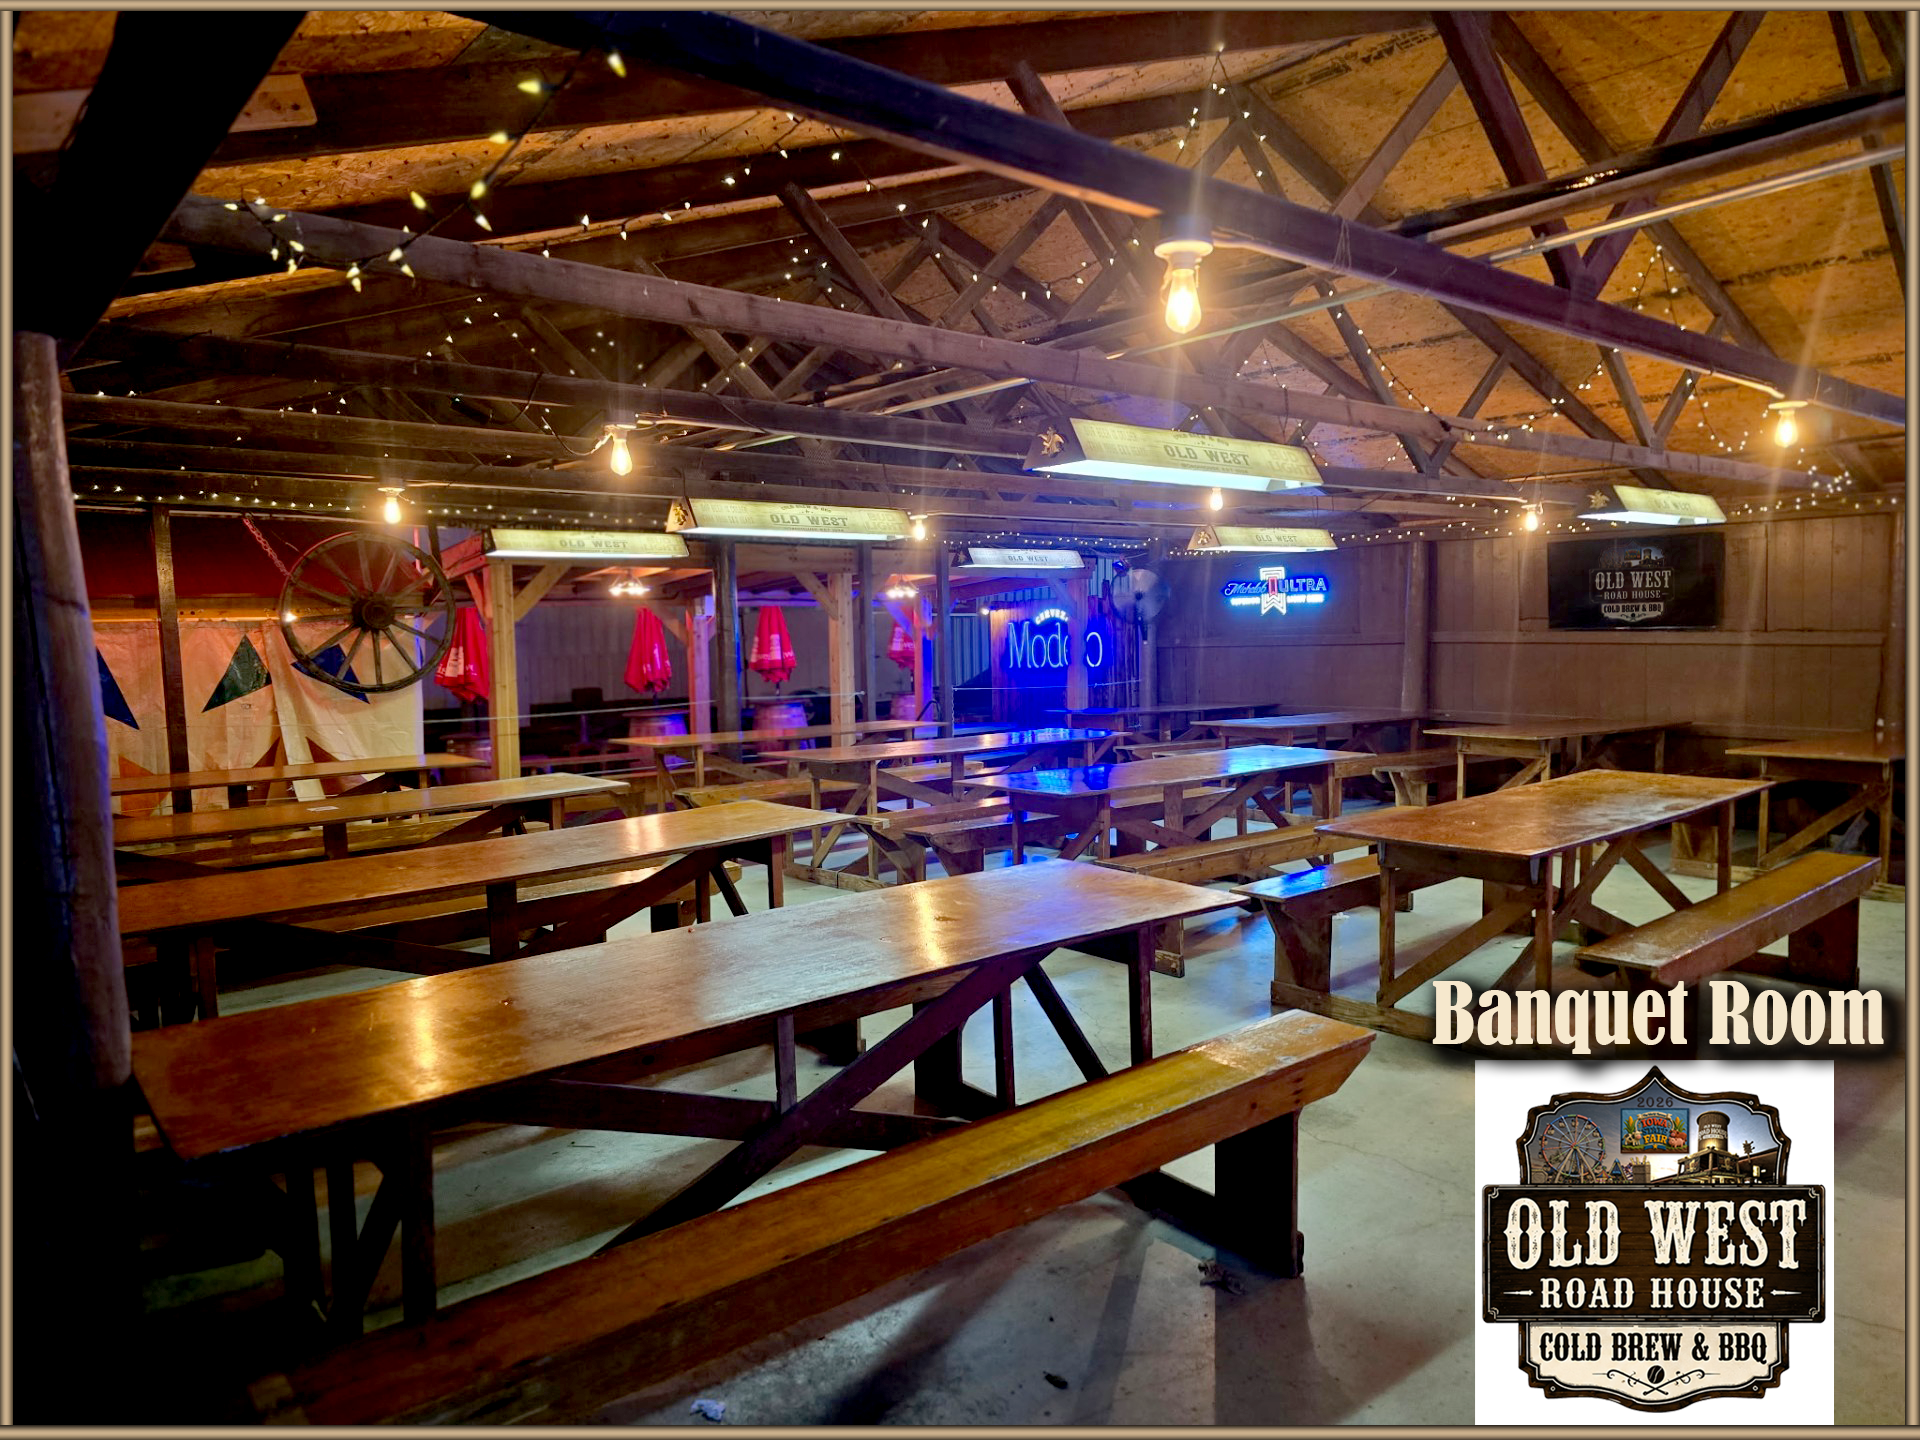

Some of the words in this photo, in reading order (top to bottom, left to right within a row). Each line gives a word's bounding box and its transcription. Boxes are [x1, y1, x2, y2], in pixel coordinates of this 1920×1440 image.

[1163, 444, 1199, 460] OLD
[1204, 449, 1249, 466] WEST
[1267, 448, 1298, 463] BUD
[769, 513, 800, 525] OLD
[807, 515, 848, 527] WEST
[559, 539, 586, 549] OLD
[591, 540, 628, 549] WEST
[1255, 534, 1273, 543] OLD
[1275, 535, 1297, 543] WEST
[1278, 577, 1327, 593] ULTRA
[1595, 571, 1625, 591] OLD
[1630, 569, 1672, 589] WEST
[1603, 590, 1629, 600] ROAD
[1631, 589, 1661, 600] HOUSE
[1603, 603, 1621, 614] COLD
[1621, 602, 1640, 613] BREW
[1641, 602, 1647, 612] &
[1648, 602, 1662, 613] BBQ
[1007, 621, 1103, 669] Modo
